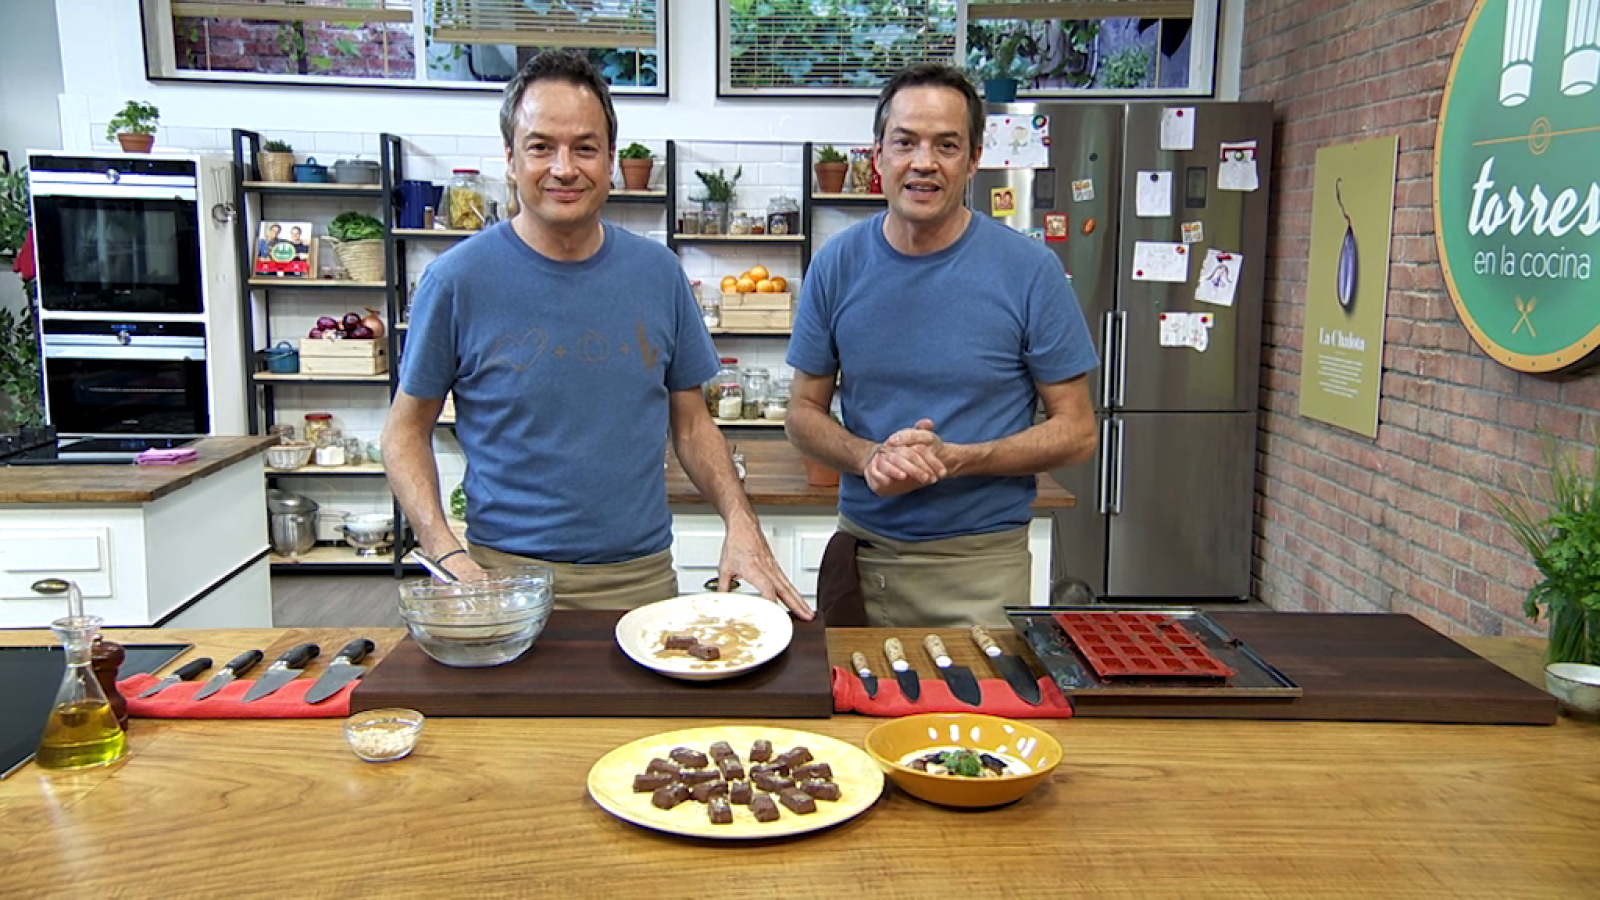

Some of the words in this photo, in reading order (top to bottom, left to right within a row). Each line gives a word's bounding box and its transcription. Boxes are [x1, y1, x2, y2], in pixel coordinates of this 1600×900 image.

[1468, 156, 1600, 236] torres
[1474, 251, 1496, 275] en
[1501, 244, 1515, 276] la
[1520, 246, 1591, 279] cocina
[1319, 327, 1331, 345] La
